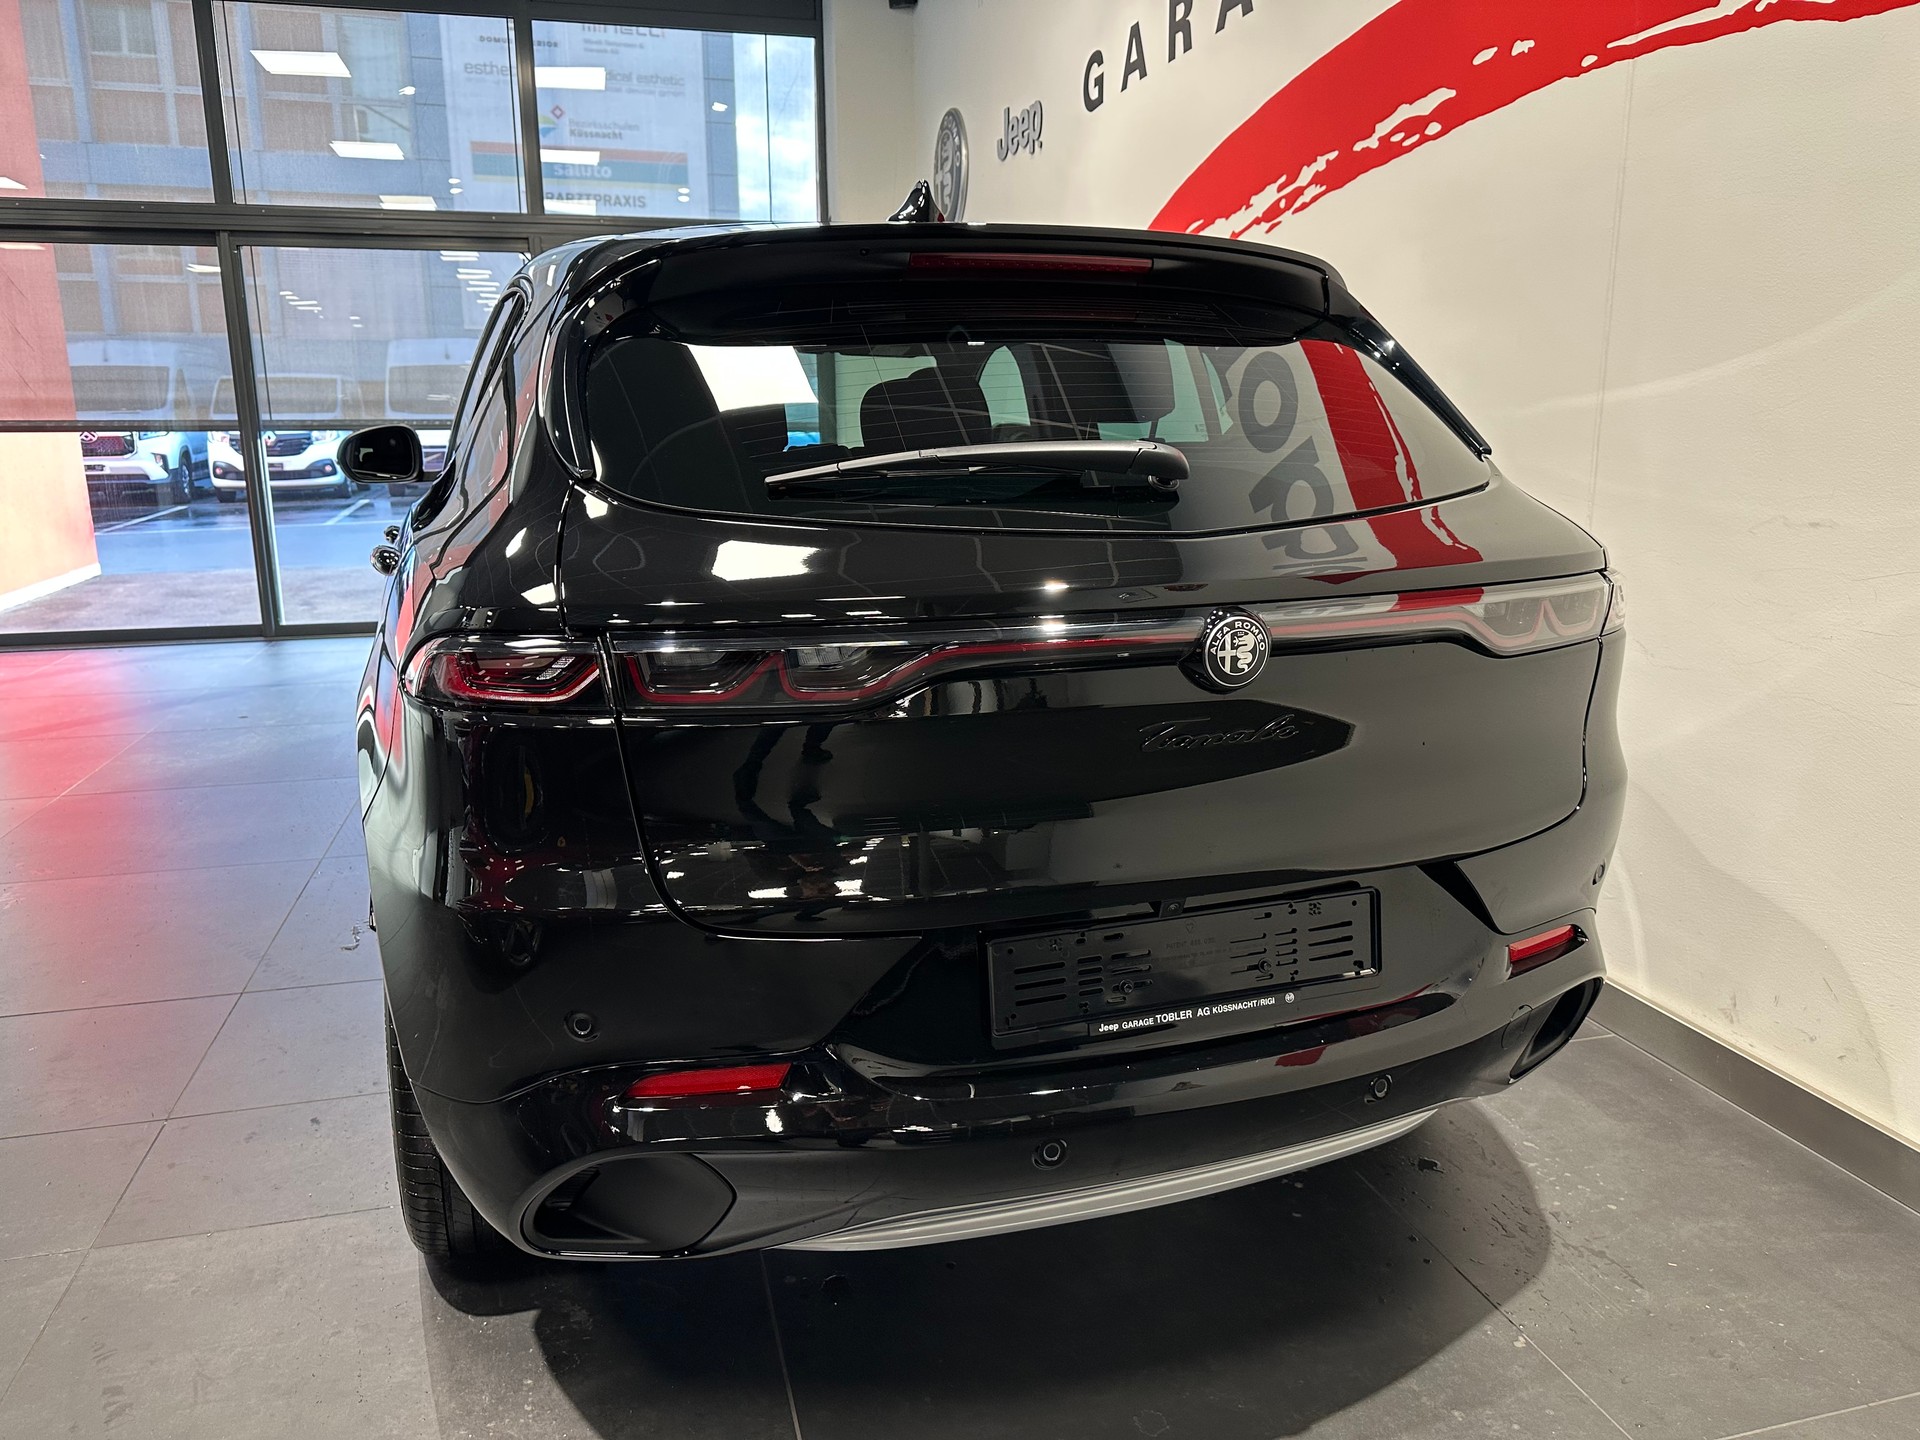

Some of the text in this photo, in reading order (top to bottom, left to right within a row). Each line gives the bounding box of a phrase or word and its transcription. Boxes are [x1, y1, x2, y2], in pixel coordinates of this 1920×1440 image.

[997, 101, 1043, 162] Jeep
[1210, 621, 1266, 655] ALFA ROMEO
[1099, 996, 1276, 1033] Jeep GARAGE TOBLER AG KÜSSNACHT/RIGI
